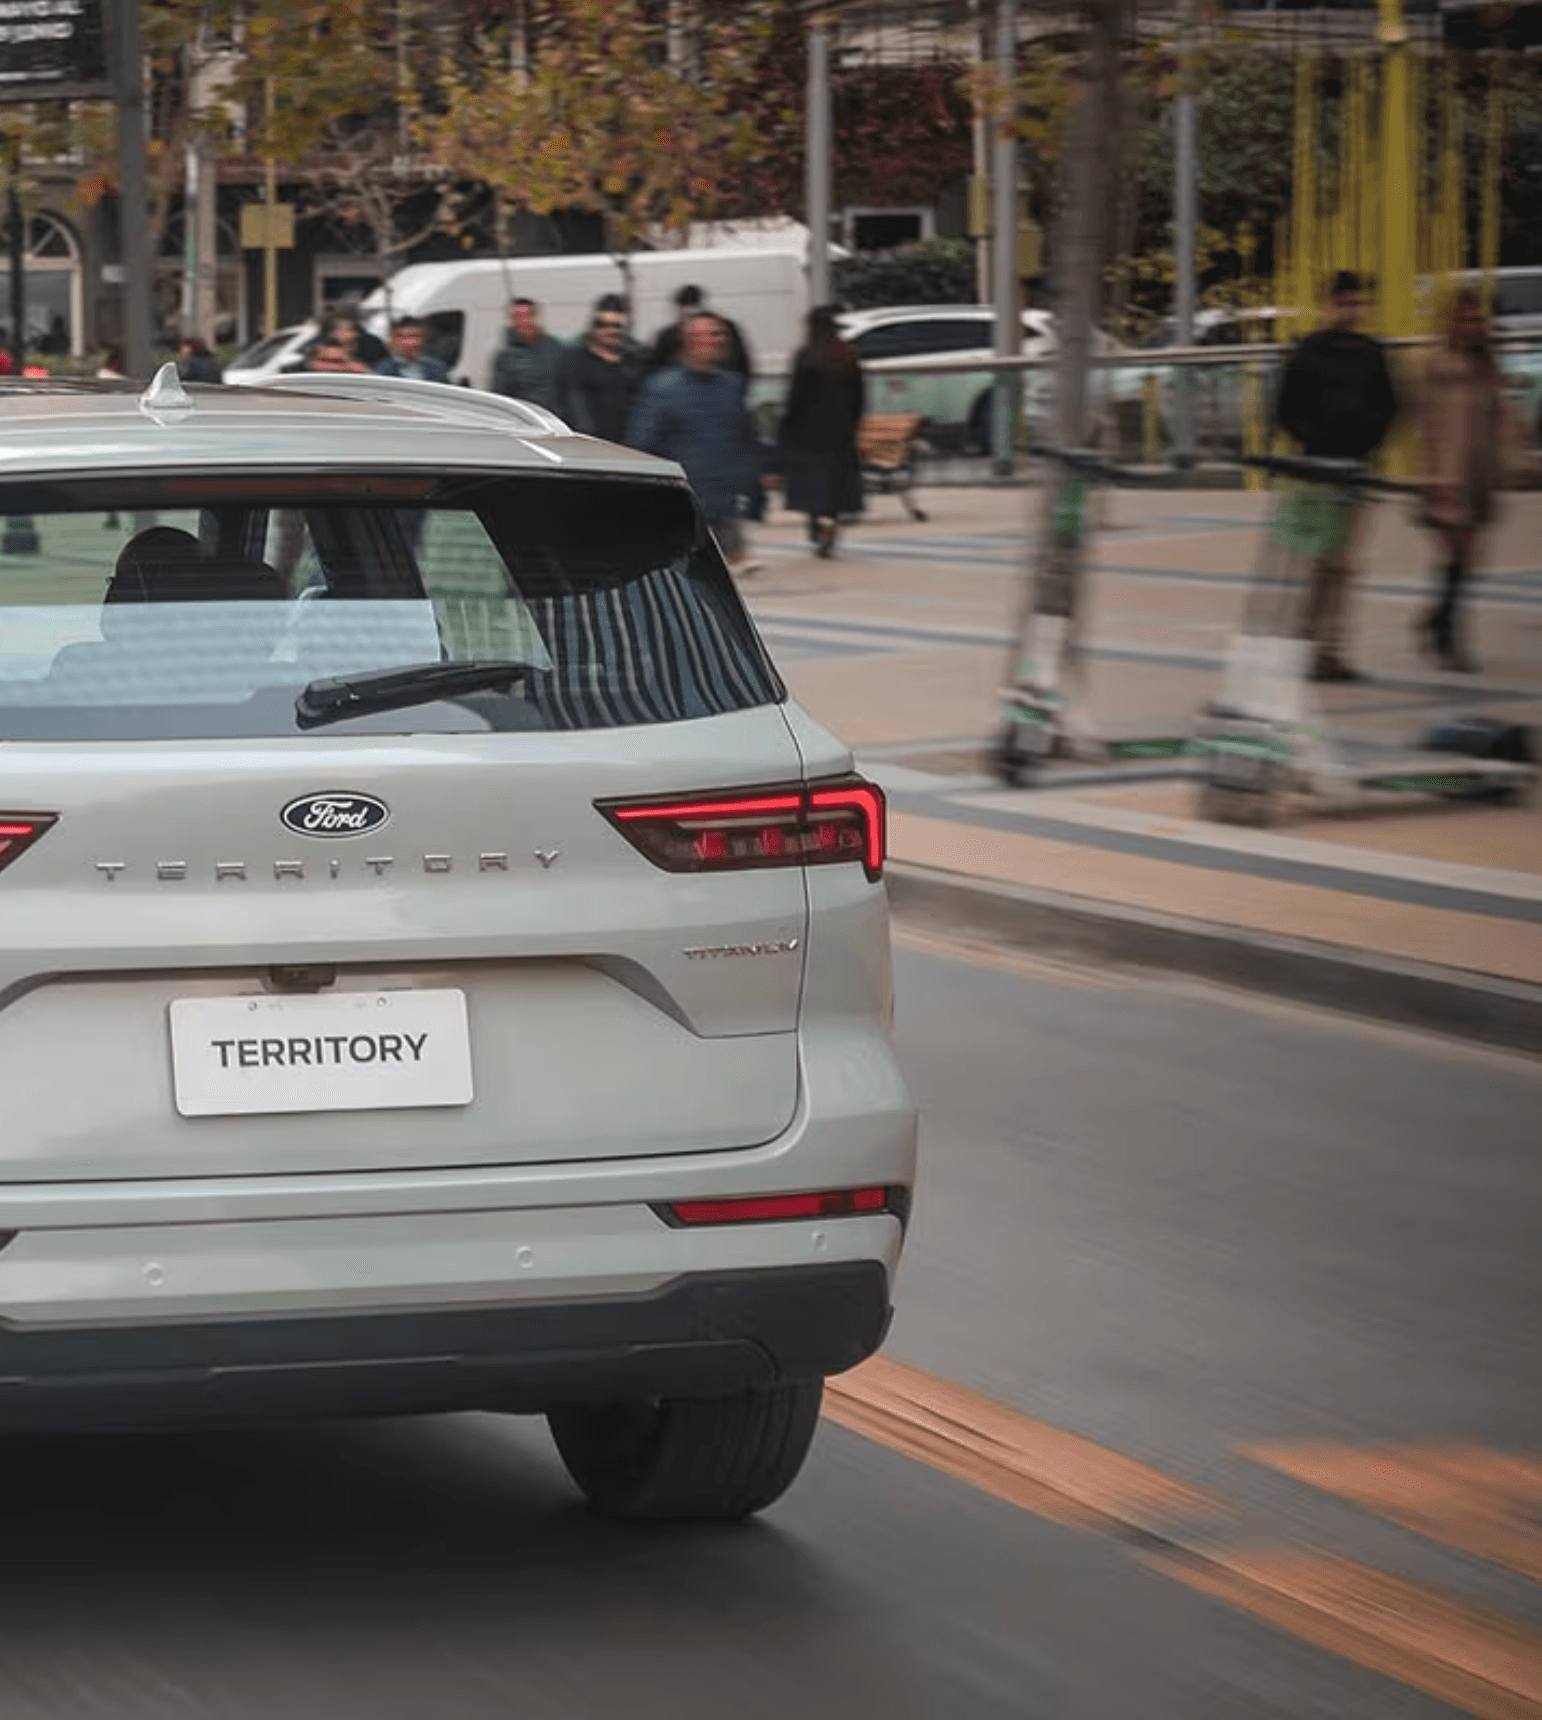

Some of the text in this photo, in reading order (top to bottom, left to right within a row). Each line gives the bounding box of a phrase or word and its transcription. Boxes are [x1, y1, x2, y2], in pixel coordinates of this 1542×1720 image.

[303, 800, 369, 829] Ford
[96, 849, 560, 882] TERRITORY
[210, 1033, 429, 1068] TERRITORY
